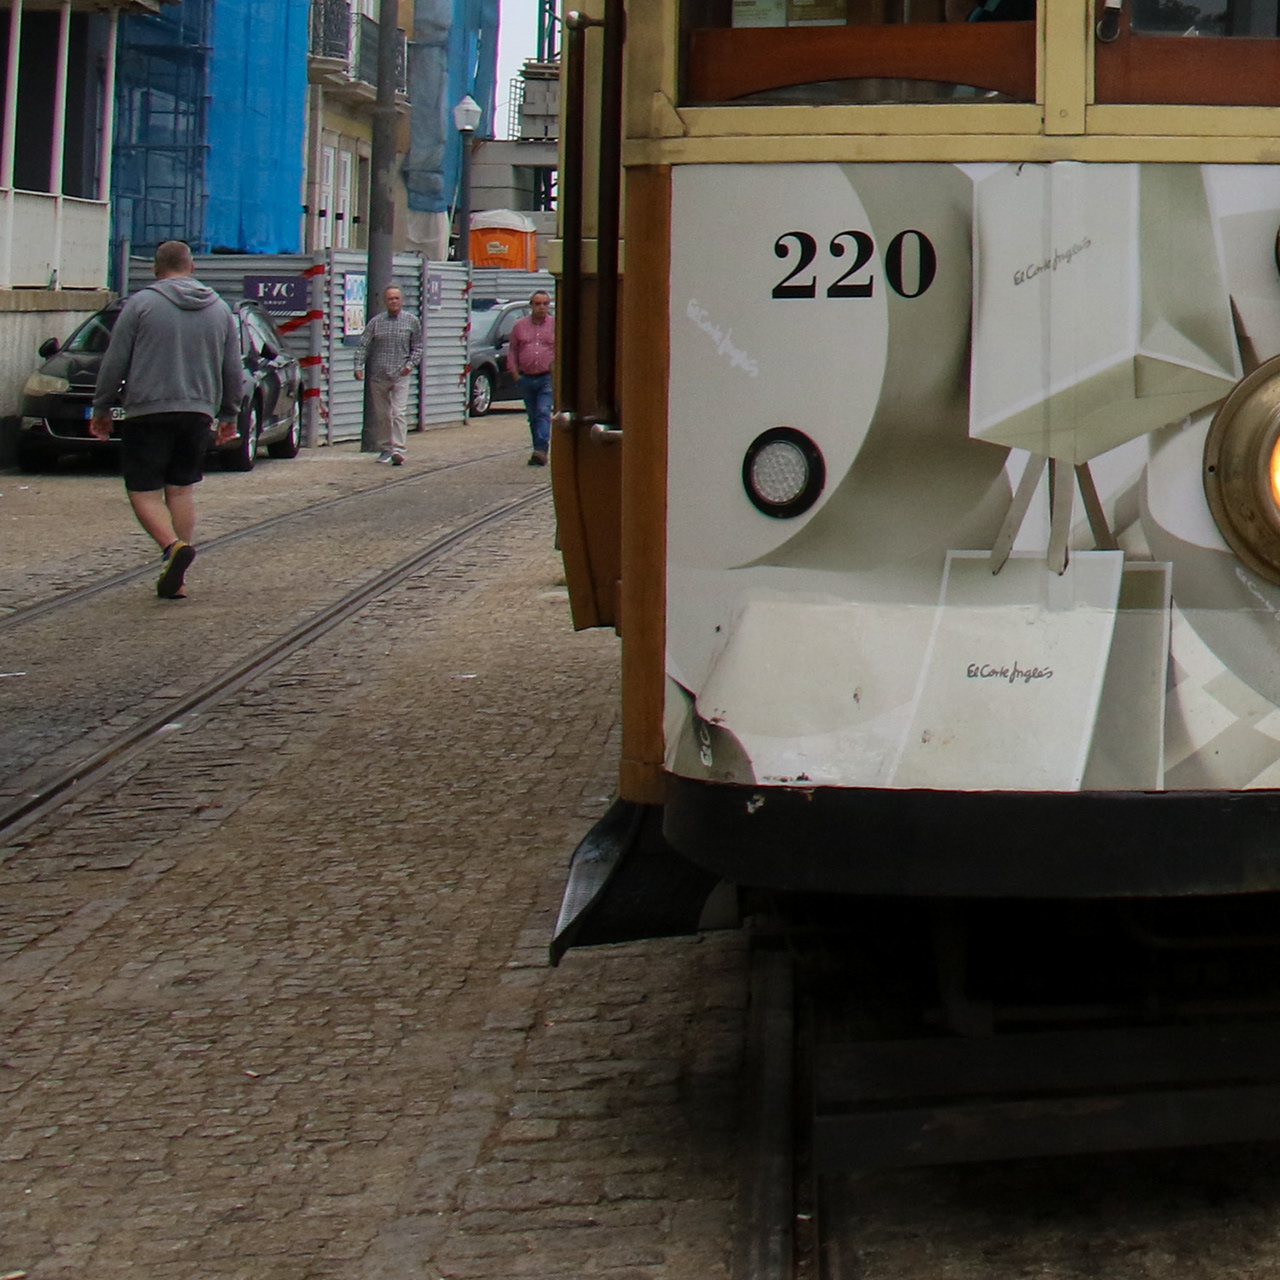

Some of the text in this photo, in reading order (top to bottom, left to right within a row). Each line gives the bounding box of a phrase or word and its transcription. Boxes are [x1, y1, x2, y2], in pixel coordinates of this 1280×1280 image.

[772, 229, 937, 299] 220
[967, 661, 1053, 683] El Corte Inglés
